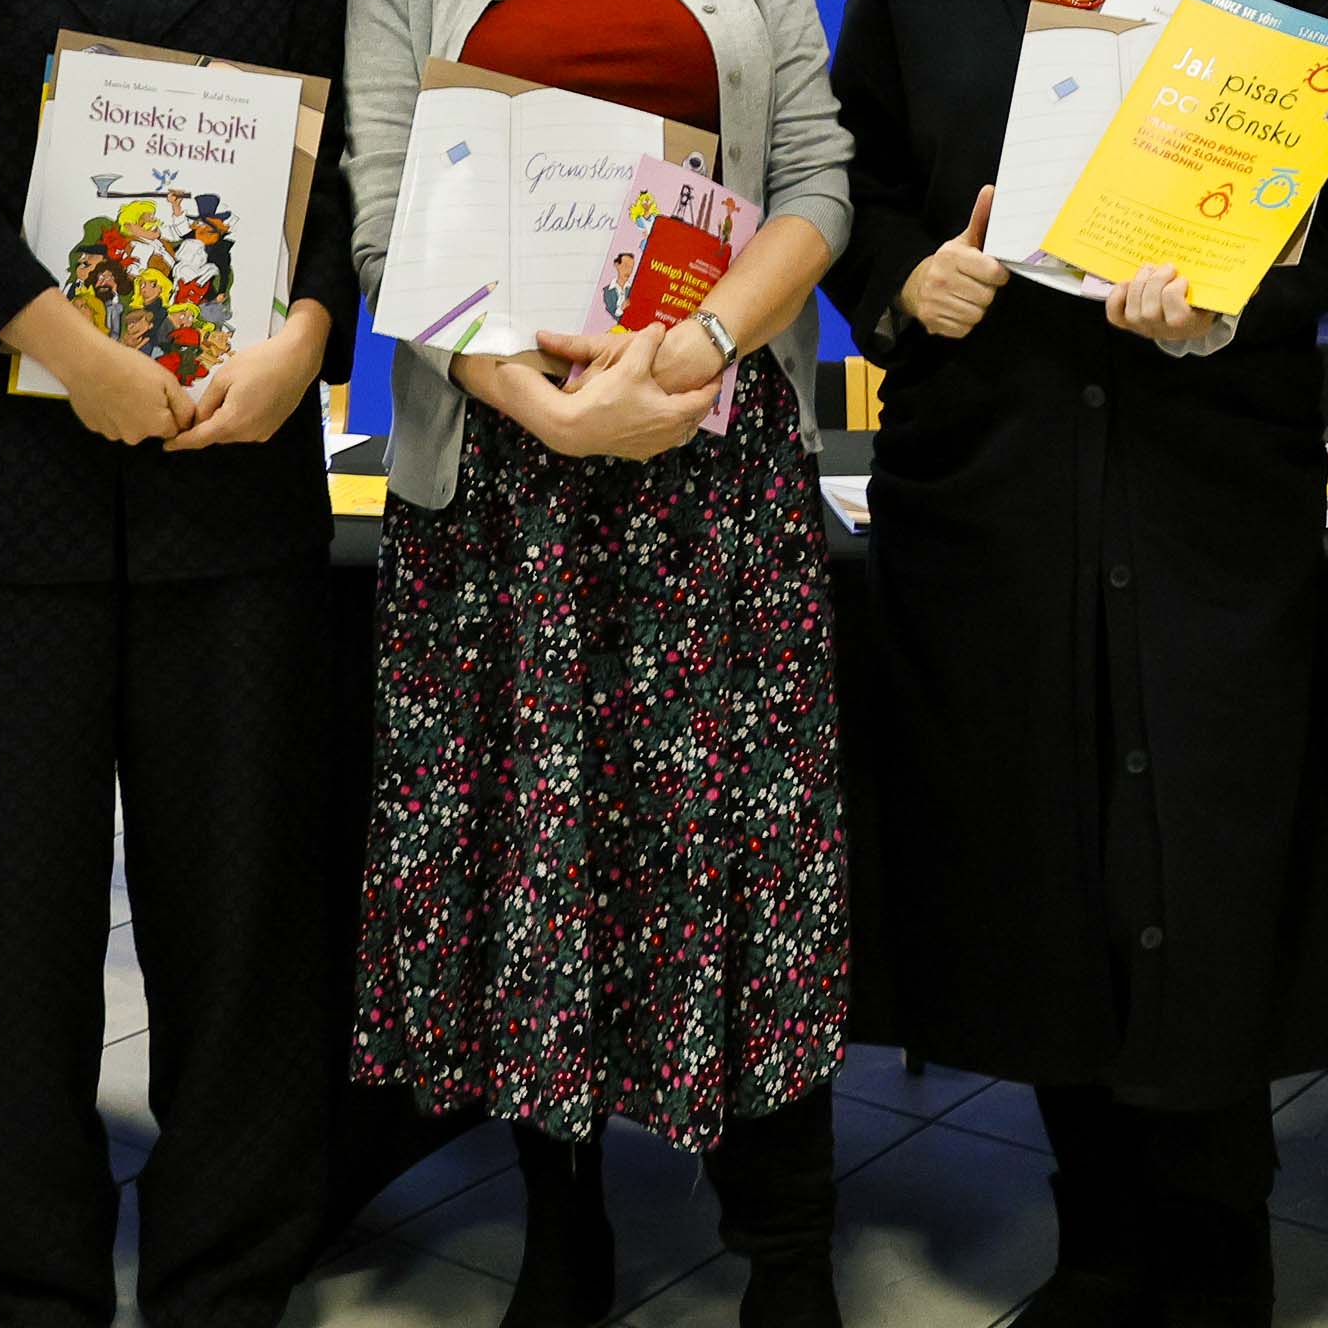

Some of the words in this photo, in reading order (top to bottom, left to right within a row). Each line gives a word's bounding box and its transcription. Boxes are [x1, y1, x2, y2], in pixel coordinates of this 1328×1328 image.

[1172, 47, 1217, 81] Jak
[1219, 72, 1299, 111] pisać
[1152, 86, 1197, 117] po
[198, 111, 257, 144] bojki
[103, 134, 134, 156] po
